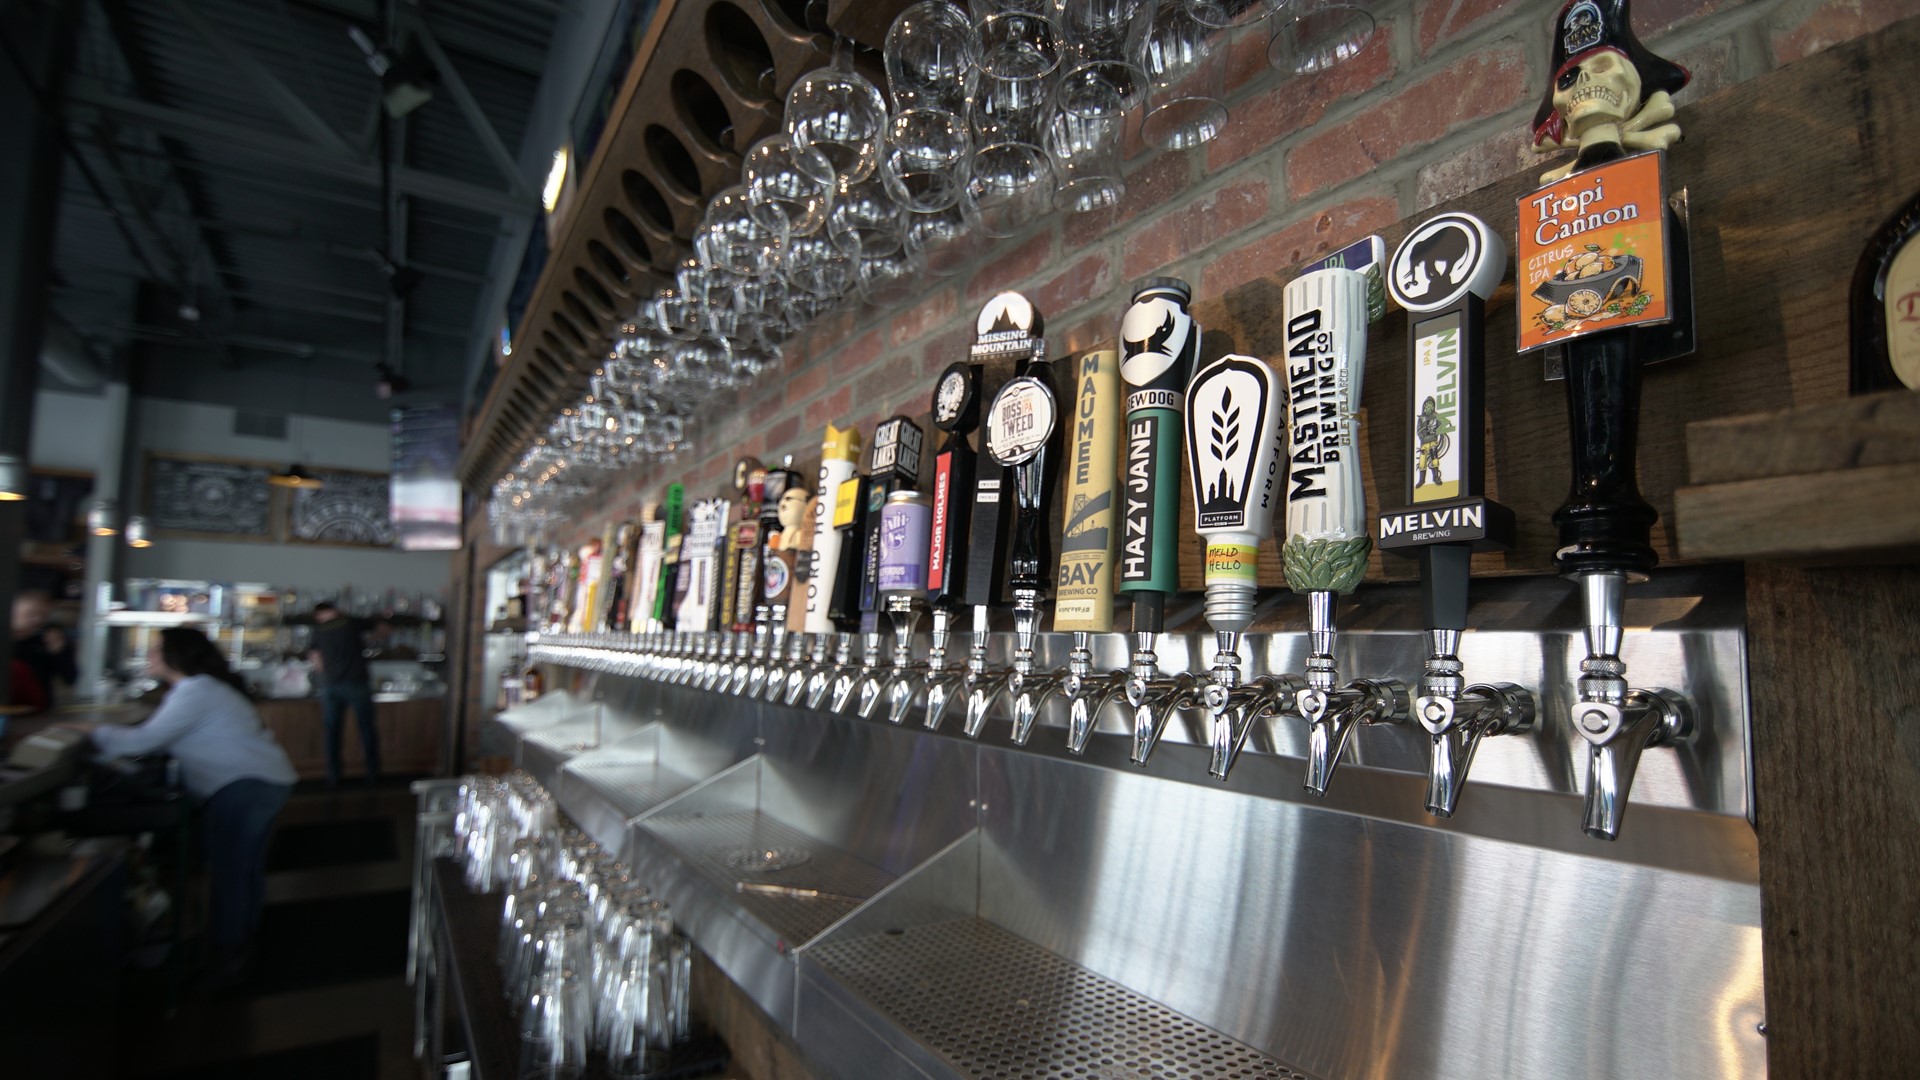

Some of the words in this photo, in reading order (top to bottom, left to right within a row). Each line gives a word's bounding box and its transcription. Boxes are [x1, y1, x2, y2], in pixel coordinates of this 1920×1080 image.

[1533, 178, 1604, 222] Tropi
[1534, 203, 1638, 246] Cannon
[1528, 244, 1574, 271] CITRUS
[1529, 269, 1550, 284] IPA
[971, 339, 1033, 355] MOUNTAIN
[977, 329, 1028, 344] MISSING
[1422, 349, 1432, 366] IPA
[1436, 328, 1457, 435] MELVIN
[1002, 400, 1022, 422] BOSS
[1075, 354, 1099, 486] MAUMEE
[1288, 308, 1327, 503] MASTHEAD
[1318, 356, 1340, 463] BREWING
[1002, 413, 1034, 439] TWEED
[1129, 420, 1152, 494] JANE
[1261, 389, 1288, 509] PLATFORM
[936, 472, 946, 524] HOLMES
[806, 550, 820, 612] LORD
[815, 466, 829, 534] HOBO
[1124, 499, 1147, 580] HAZY
[1380, 505, 1482, 539] MELVIN
[1412, 530, 1451, 541] BREWING
[932, 526, 943, 570] MAJOR
[1209, 559, 1241, 572] HELLO
[1059, 562, 1104, 587] BAY
[1086, 587, 1098, 595] CO
